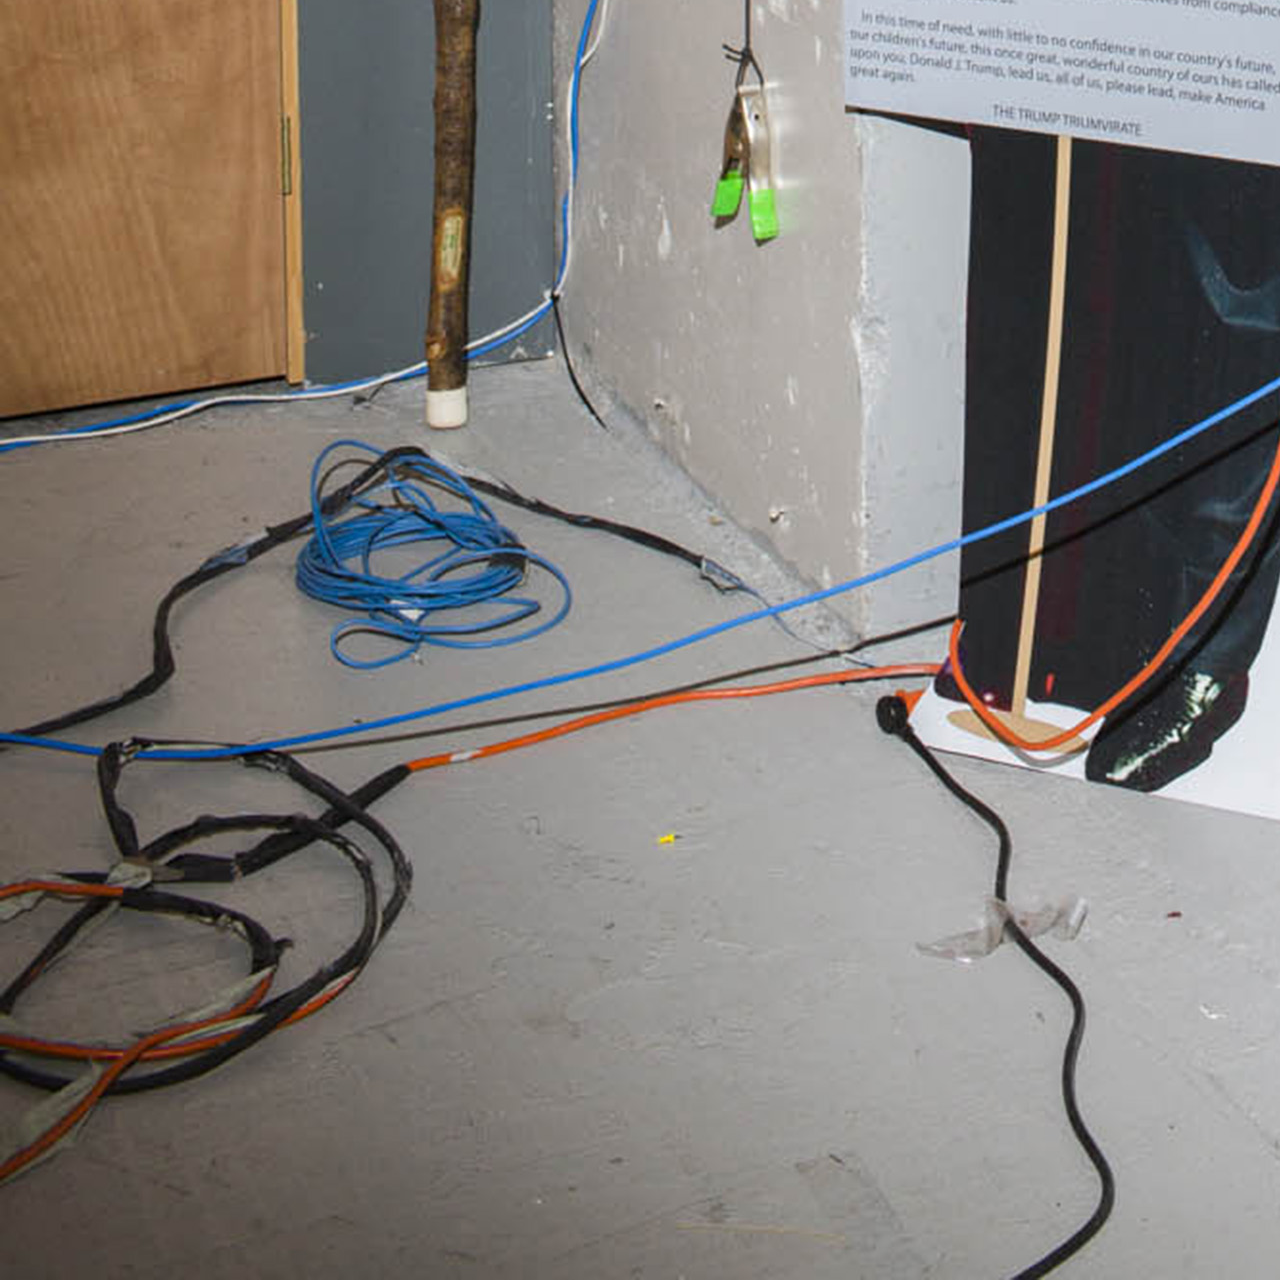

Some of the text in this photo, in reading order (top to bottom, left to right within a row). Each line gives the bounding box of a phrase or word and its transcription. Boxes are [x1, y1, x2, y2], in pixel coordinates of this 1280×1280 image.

[849, 28, 869, 40] our
[871, 30, 926, 48] children's
[970, 42, 991, 56] this
[993, 47, 1022, 60] once
[1062, 57, 1124, 73] wonderful
[1126, 64, 1174, 82] country
[1176, 67, 1190, 81] of
[1191, 72, 1218, 85] ours
[1221, 73, 1242, 89] has
[861, 8, 872, 24] In
[874, 13, 896, 27] this
[898, 16, 925, 30] time
[927, 19, 940, 31] of
[977, 25, 1003, 39] with
[1006, 27, 1034, 44] little
[1035, 33, 1049, 45] to
[1050, 36, 1066, 47] no
[1068, 37, 1136, 56] confidence
[1138, 46, 1151, 57] in
[1152, 49, 1174, 60] our
[1176, 51, 1232, 69] country's
[849, 65, 879, 78] great
[849, 47, 880, 60] upon
[909, 52, 952, 70] Donald
[1007, 65, 1033, 80] lead
[1054, 71, 1069, 85] all
[1071, 73, 1084, 87] of
[1105, 78, 1144, 95] please
[1177, 89, 1212, 104] make
[1214, 91, 1265, 111] America
[992, 103, 1142, 136] THE TRUMP TRIUMVIRATE
